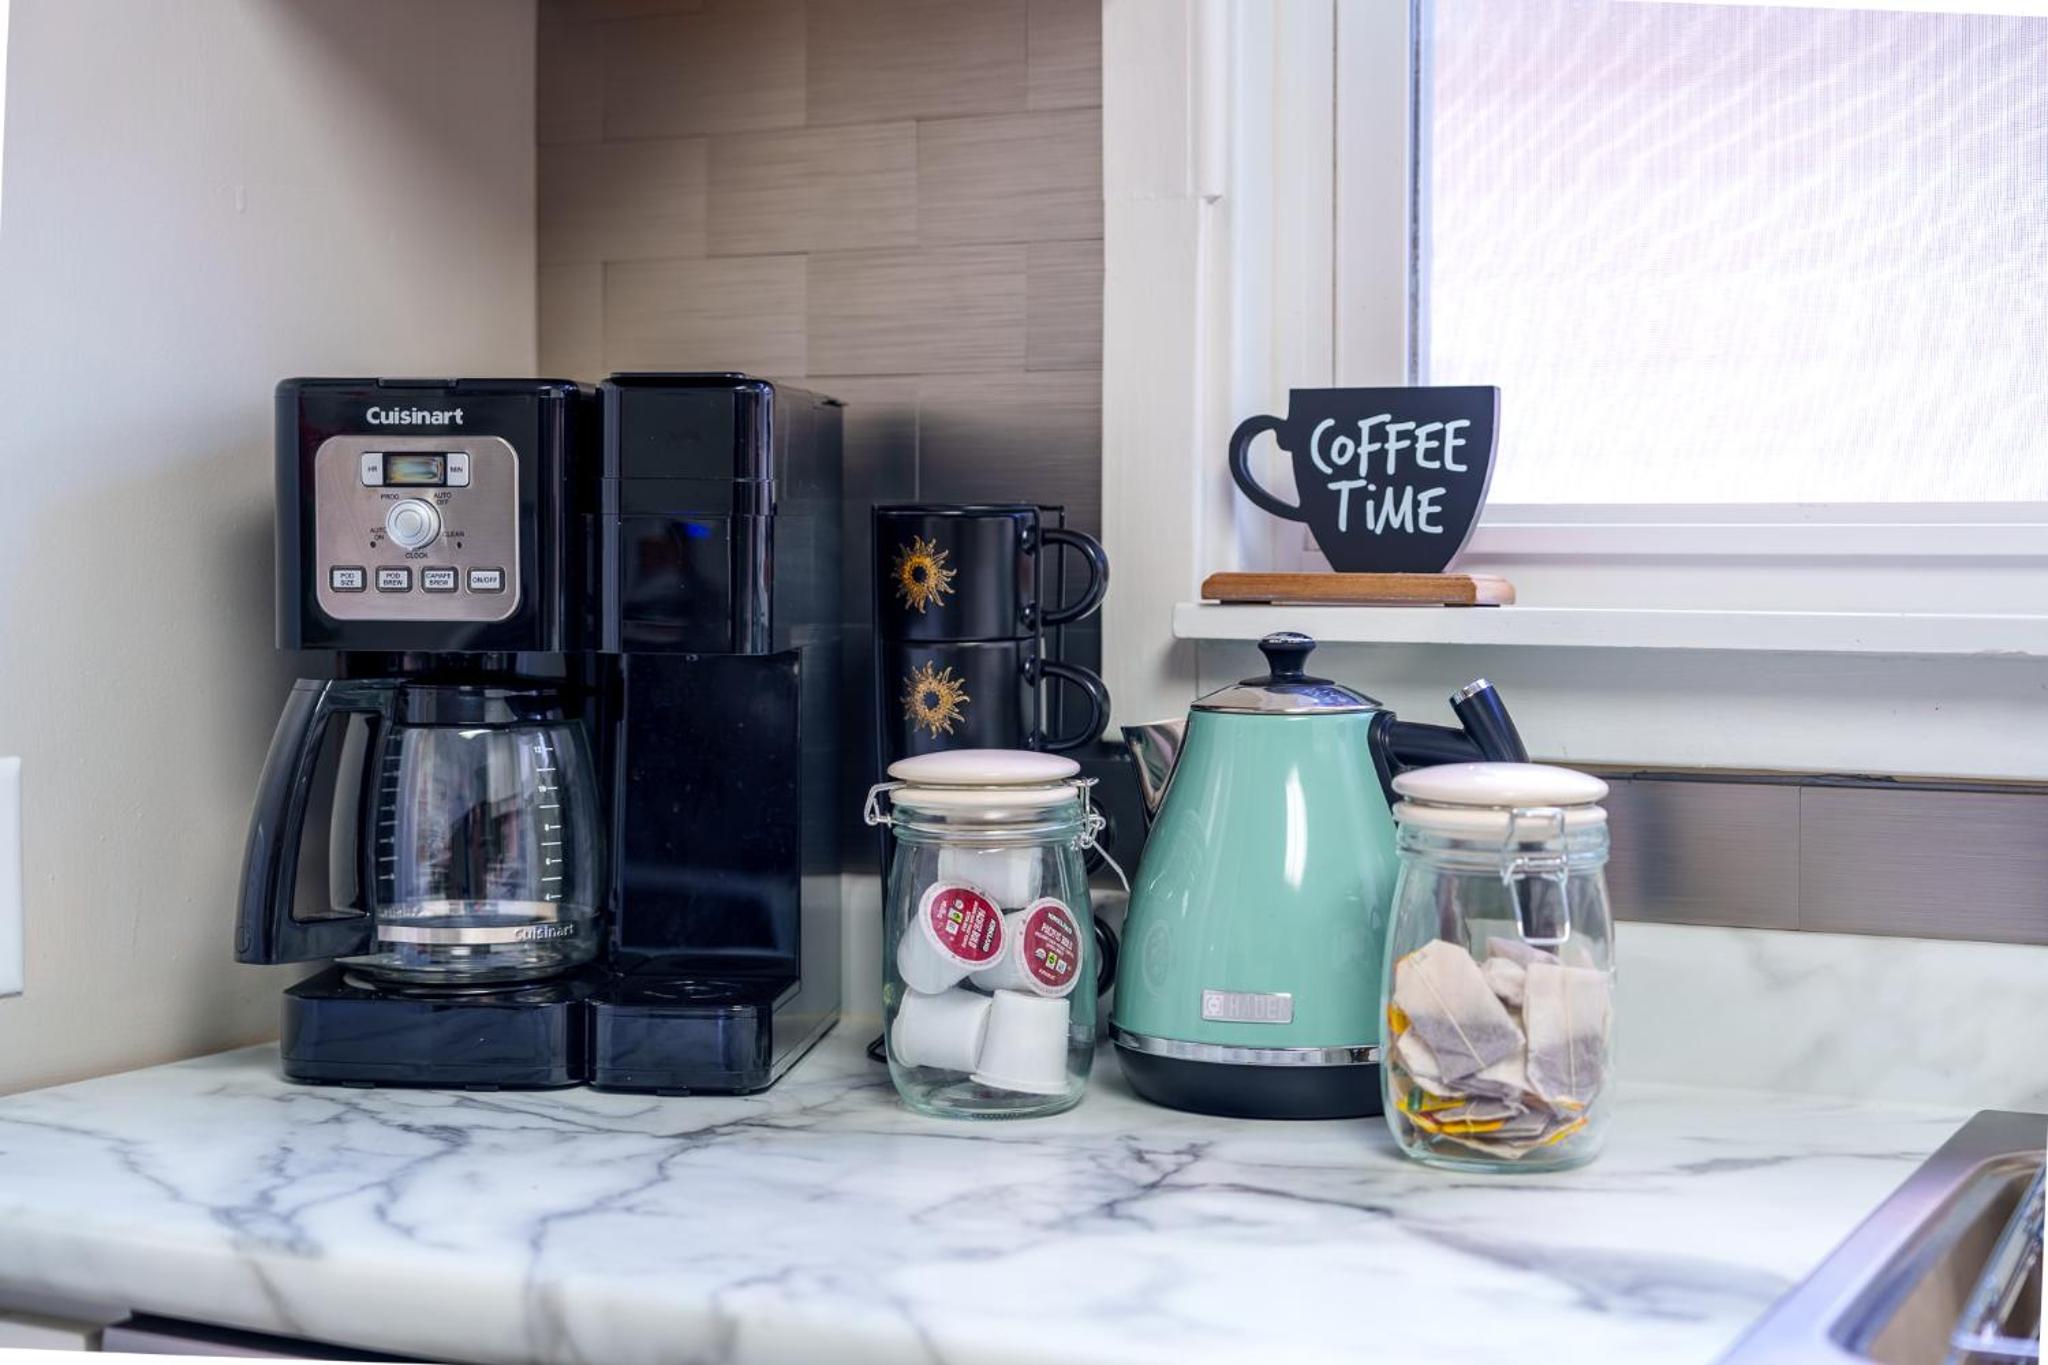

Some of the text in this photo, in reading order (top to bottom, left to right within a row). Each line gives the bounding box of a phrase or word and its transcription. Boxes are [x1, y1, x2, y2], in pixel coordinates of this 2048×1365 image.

[366, 407, 464, 425] Cuisinart
[381, 493, 400, 501] PROG
[472, 576, 498, 584] ON/OFF
[514, 923, 574, 939] Cuisinart
